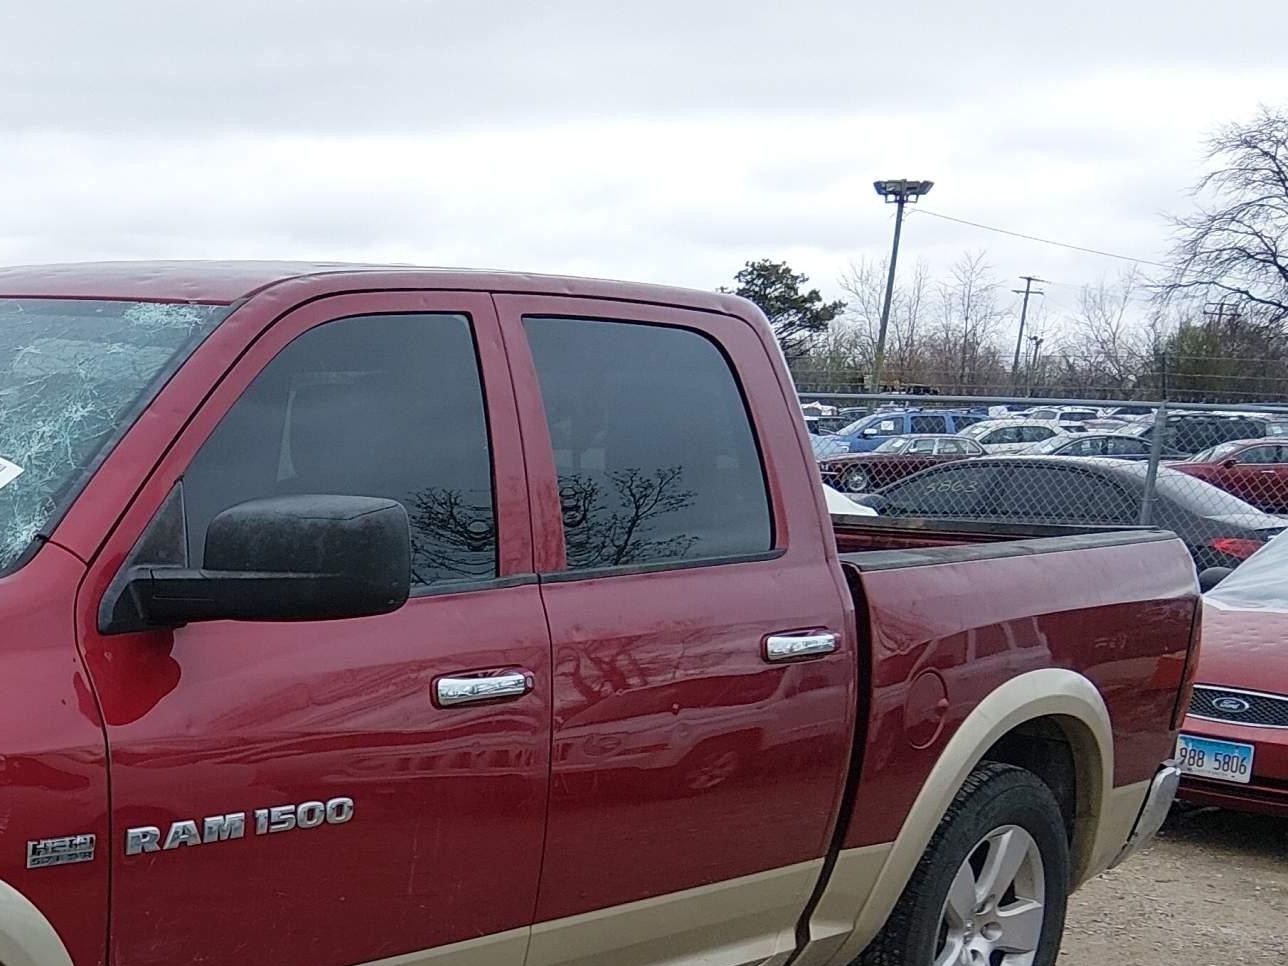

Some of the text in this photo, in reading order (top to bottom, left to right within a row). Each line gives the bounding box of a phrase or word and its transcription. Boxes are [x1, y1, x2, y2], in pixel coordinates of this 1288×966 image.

[1179, 747, 1206, 768] 988
[1213, 752, 1247, 775] 5806
[125, 797, 355, 856] RAM 1500
